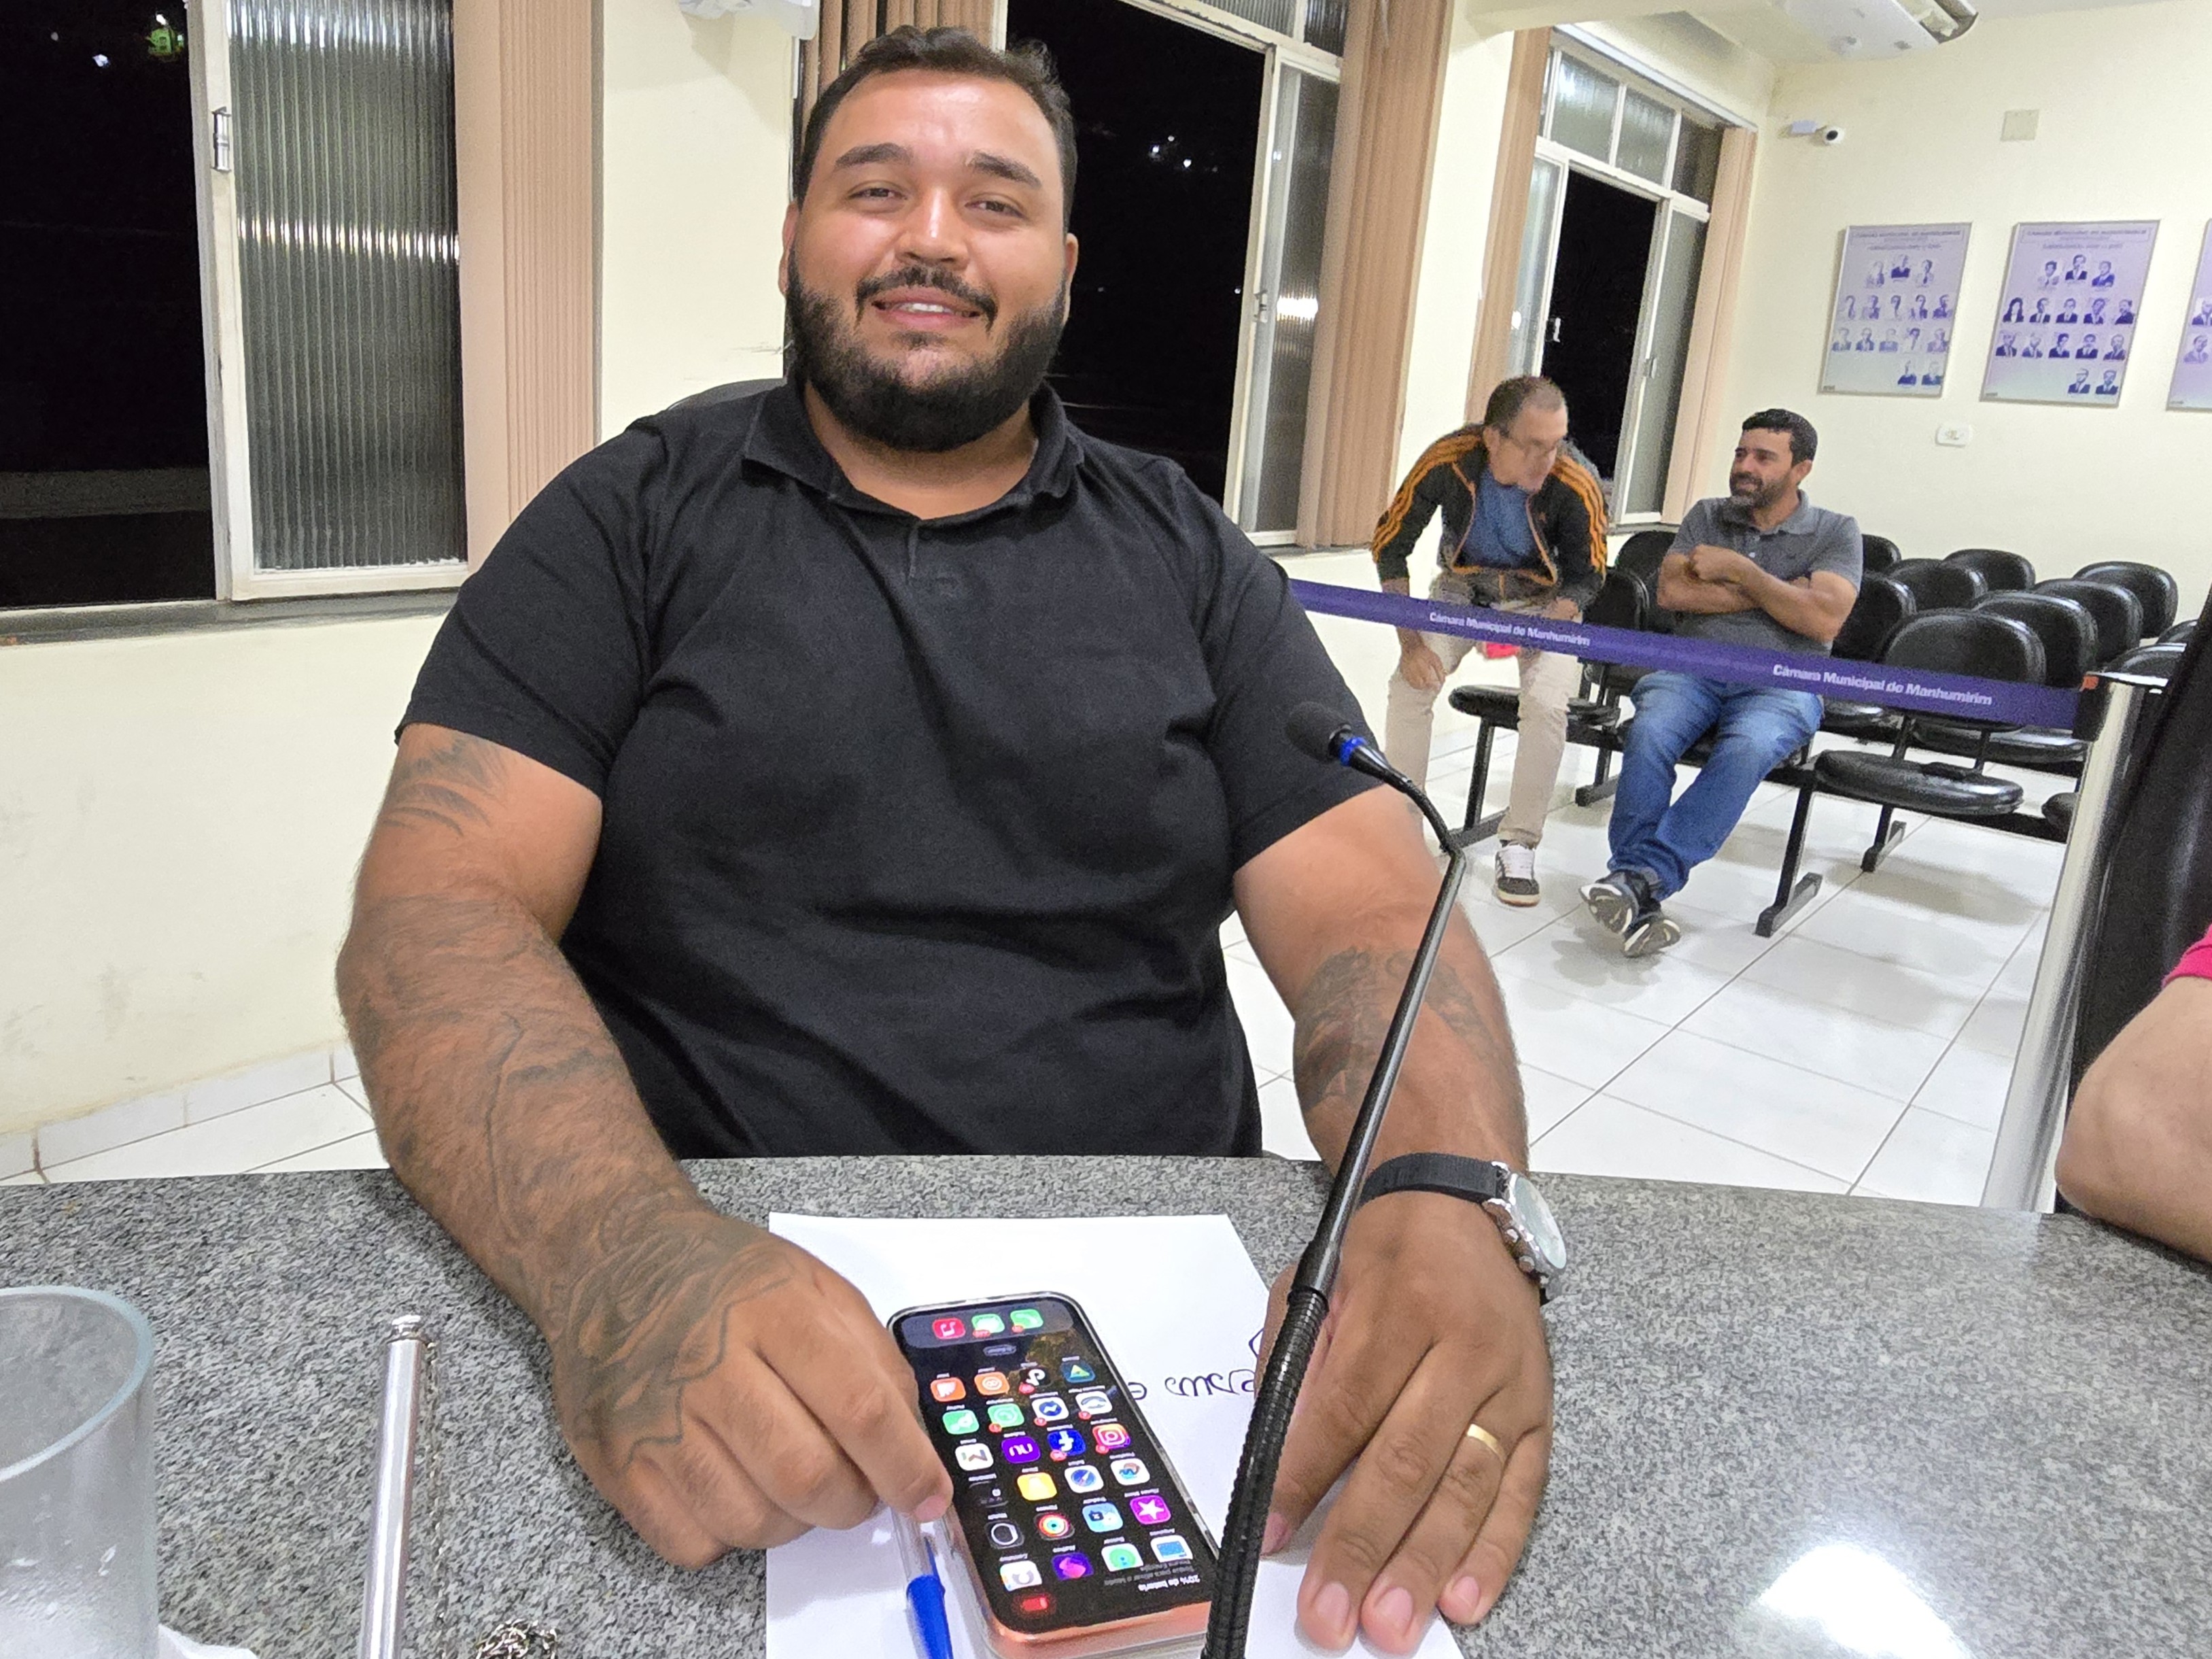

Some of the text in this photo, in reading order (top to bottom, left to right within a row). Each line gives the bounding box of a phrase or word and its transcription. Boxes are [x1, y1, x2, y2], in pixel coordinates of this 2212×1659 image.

[1466, 617, 1511, 634] Municipal
[1527, 627, 1590, 646] Manhumirim
[1773, 664, 1821, 681] Câmara
[1823, 672, 1886, 691] Municipal
[1905, 683, 1992, 705] Manhumirim
